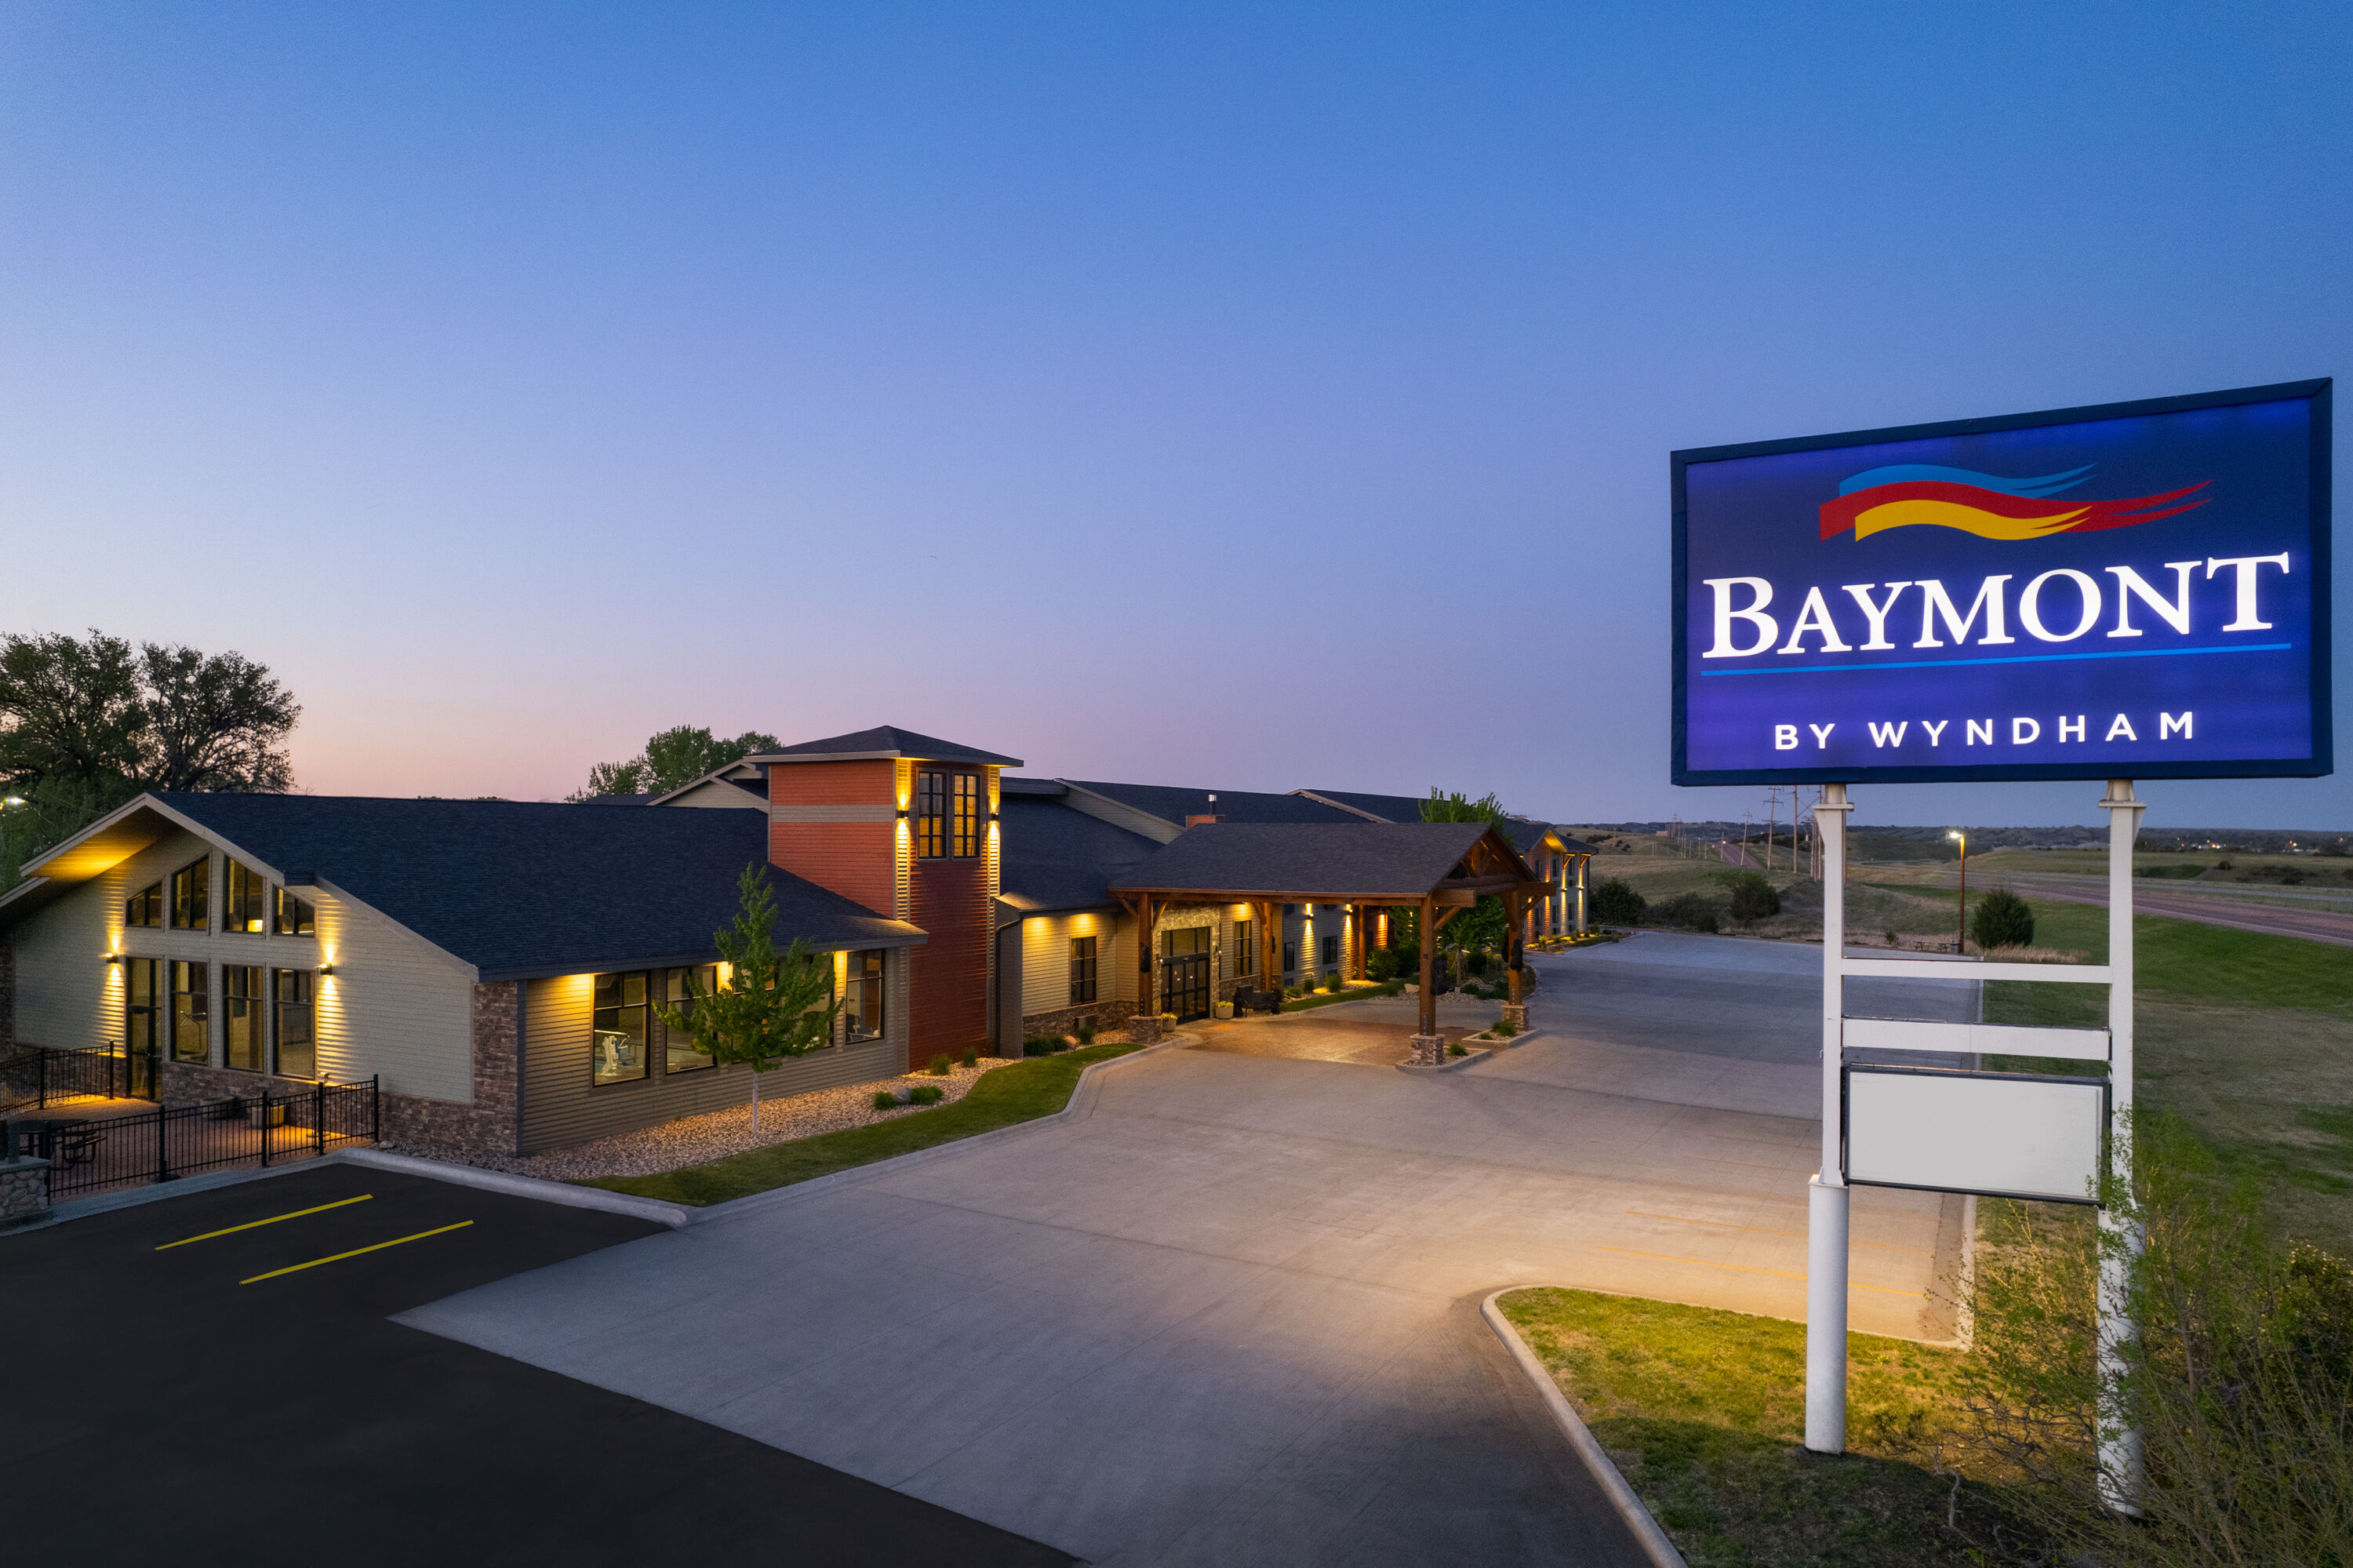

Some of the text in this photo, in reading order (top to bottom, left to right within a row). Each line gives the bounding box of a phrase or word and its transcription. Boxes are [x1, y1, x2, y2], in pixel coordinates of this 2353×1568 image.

[1702, 552, 2289, 658] BAYMONT
[1775, 711, 2193, 751] BY WYNDHAM
